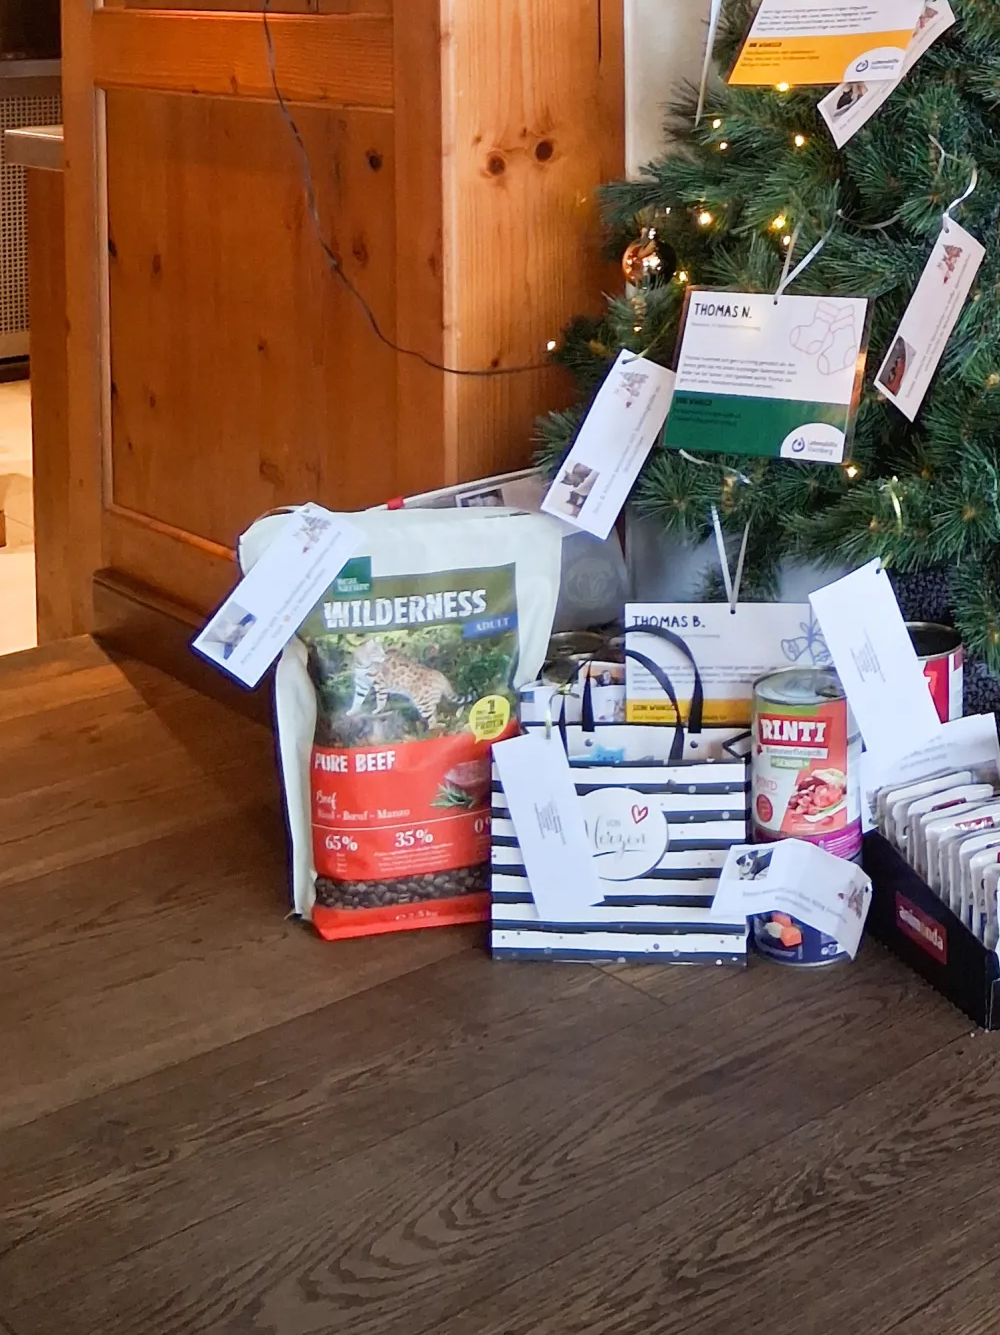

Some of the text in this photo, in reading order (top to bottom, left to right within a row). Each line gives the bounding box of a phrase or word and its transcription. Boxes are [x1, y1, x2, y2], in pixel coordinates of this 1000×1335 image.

[694, 303, 752, 319] THOMAS N.
[324, 589, 487, 629] WILDERNESS
[474, 617, 509, 631] ADULT
[632, 615, 706, 628] THOMAS B.
[761, 719, 826, 742] RINTI
[315, 750, 396, 773] PURE BEEF
[325, 836, 358, 851] 65%
[395, 829, 434, 847] 35%
